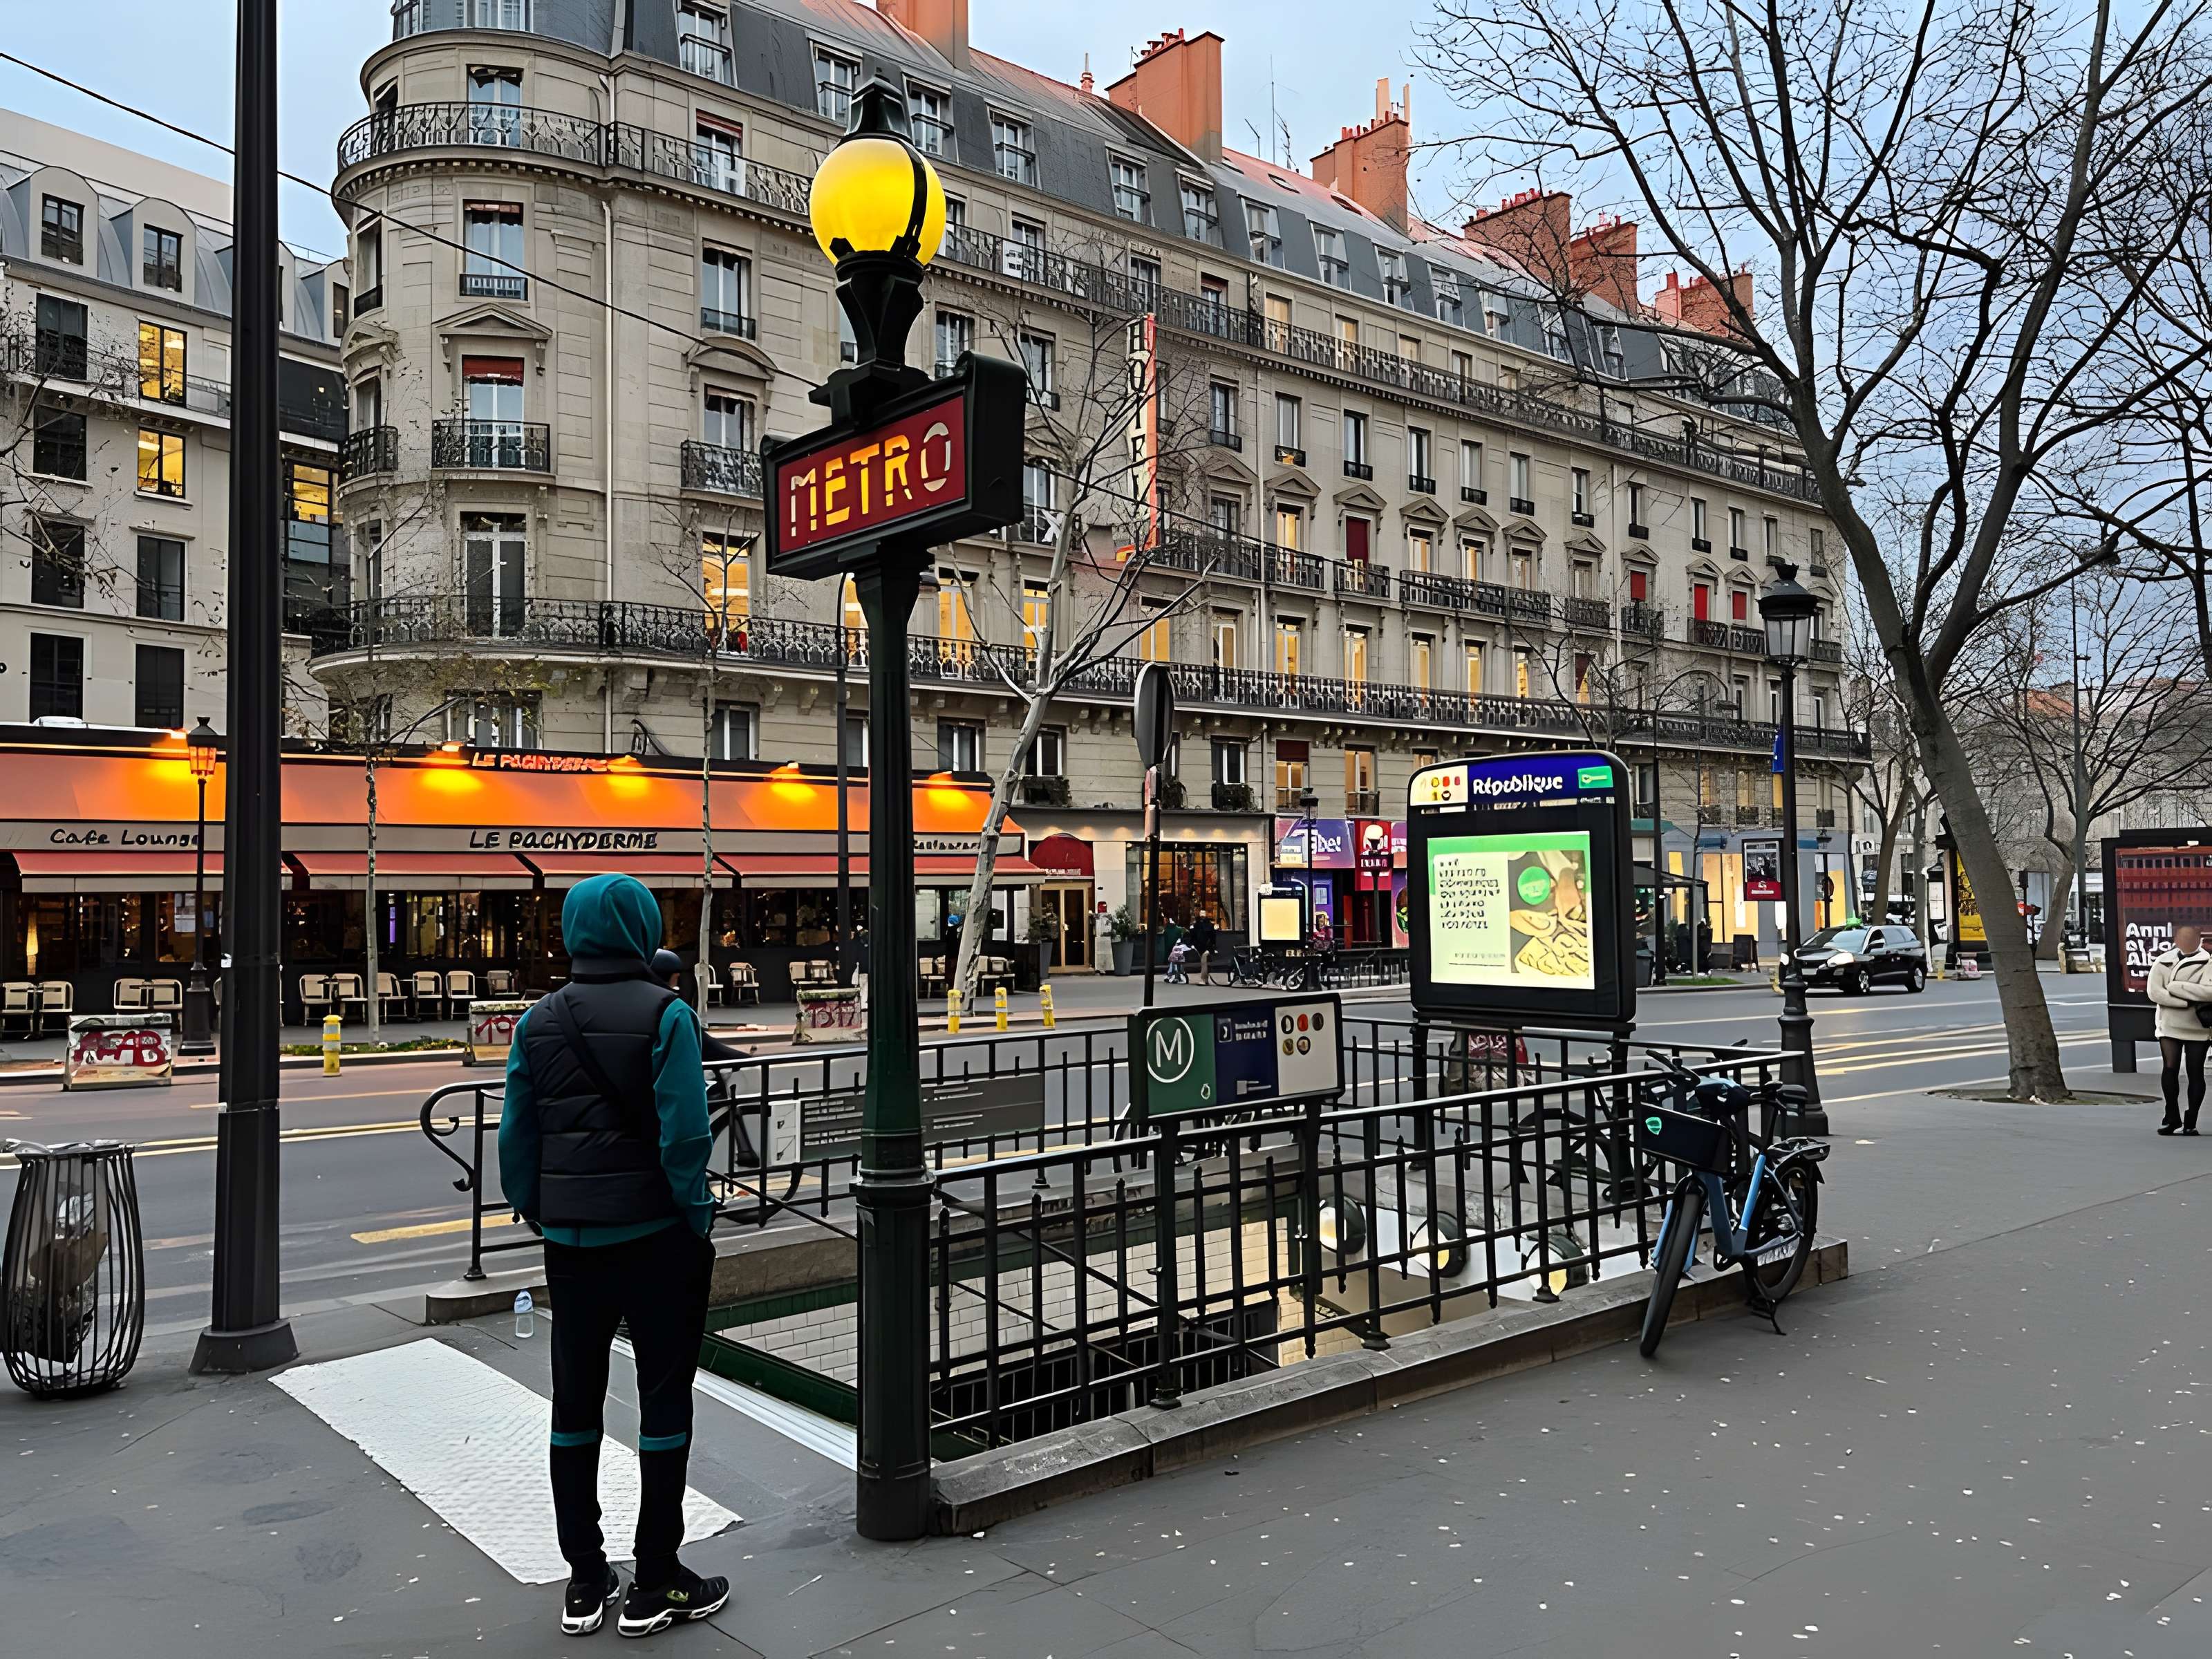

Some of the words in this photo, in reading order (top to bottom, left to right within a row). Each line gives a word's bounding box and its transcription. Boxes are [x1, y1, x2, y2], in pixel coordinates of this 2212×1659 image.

[791, 422, 951, 537] METRO
[469, 830, 500, 849] LE
[509, 831, 658, 850] PACHYDERME
[1156, 1028, 1182, 1068] M
